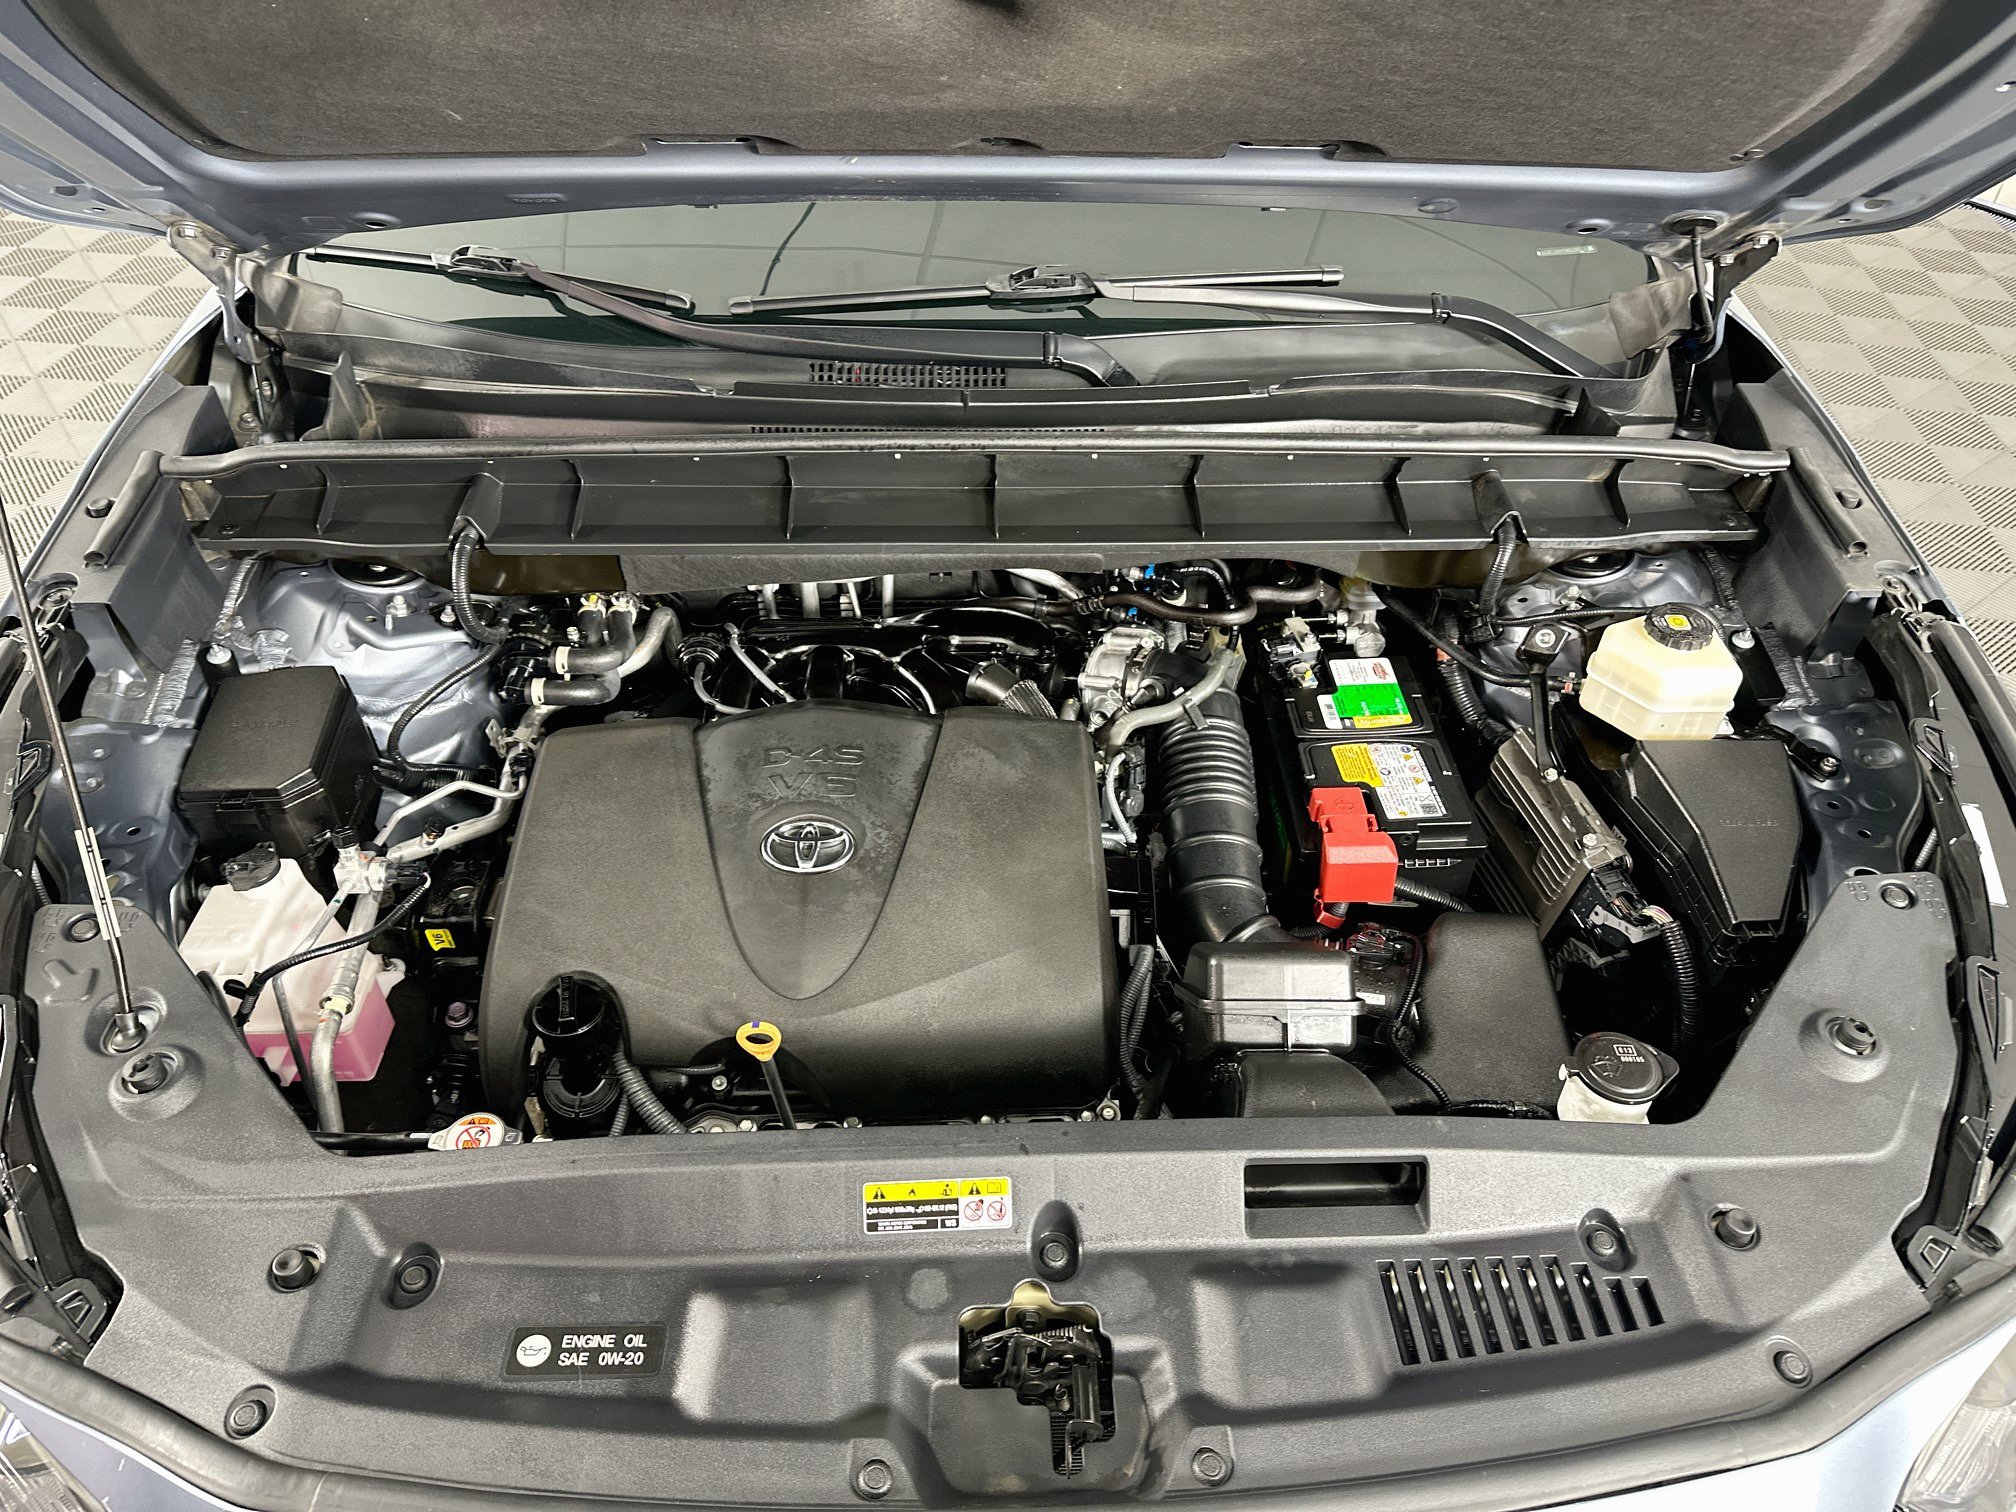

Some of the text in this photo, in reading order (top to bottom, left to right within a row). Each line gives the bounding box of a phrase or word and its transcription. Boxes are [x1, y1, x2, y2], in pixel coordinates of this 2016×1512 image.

[763, 744, 865, 768] D-4S
[767, 773, 858, 797] V6
[432, 933, 444, 946] V6
[561, 1333, 648, 1349] ENGINE OIL
[558, 1351, 645, 1366] SAE 0W-20
